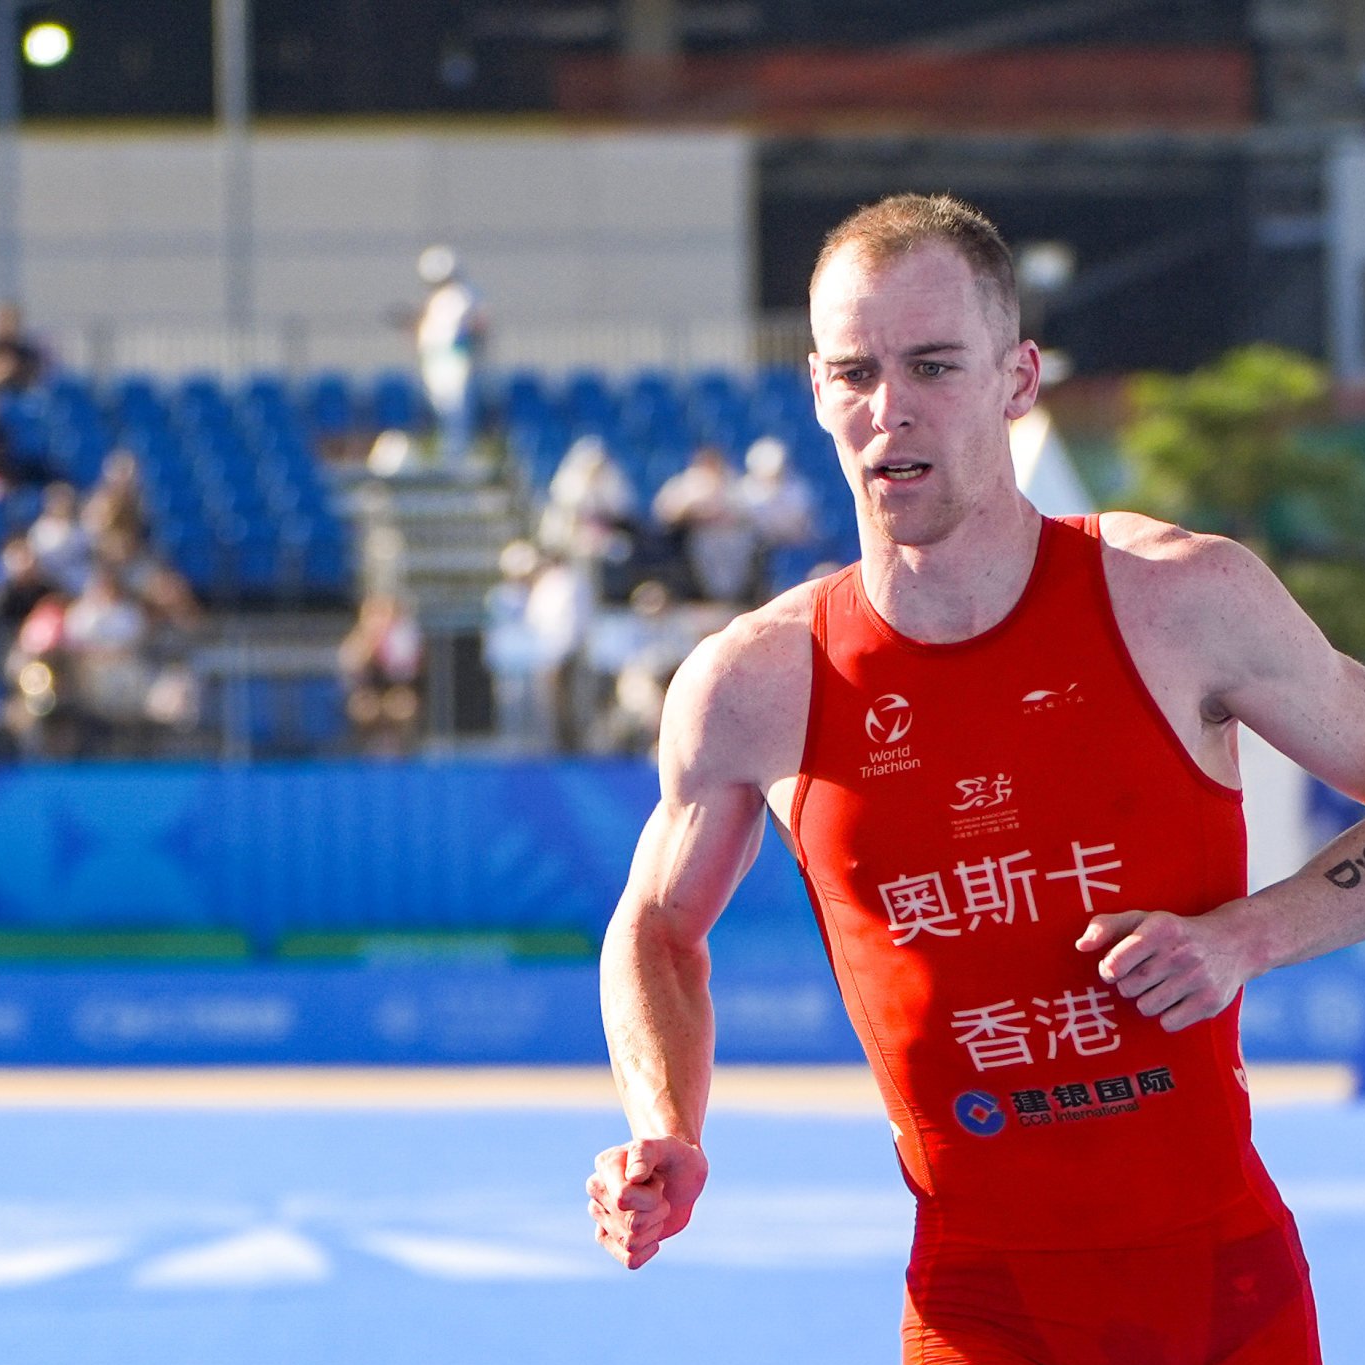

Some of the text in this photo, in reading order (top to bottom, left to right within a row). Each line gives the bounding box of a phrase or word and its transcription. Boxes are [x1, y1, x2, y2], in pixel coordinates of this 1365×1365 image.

[869, 744, 910, 763] World
[859, 758, 921, 779] Triathlon
[950, 986, 1121, 1073] 香港
[1010, 1066, 1175, 1114] 建银国际
[1018, 1102, 1140, 1128] CCB International
